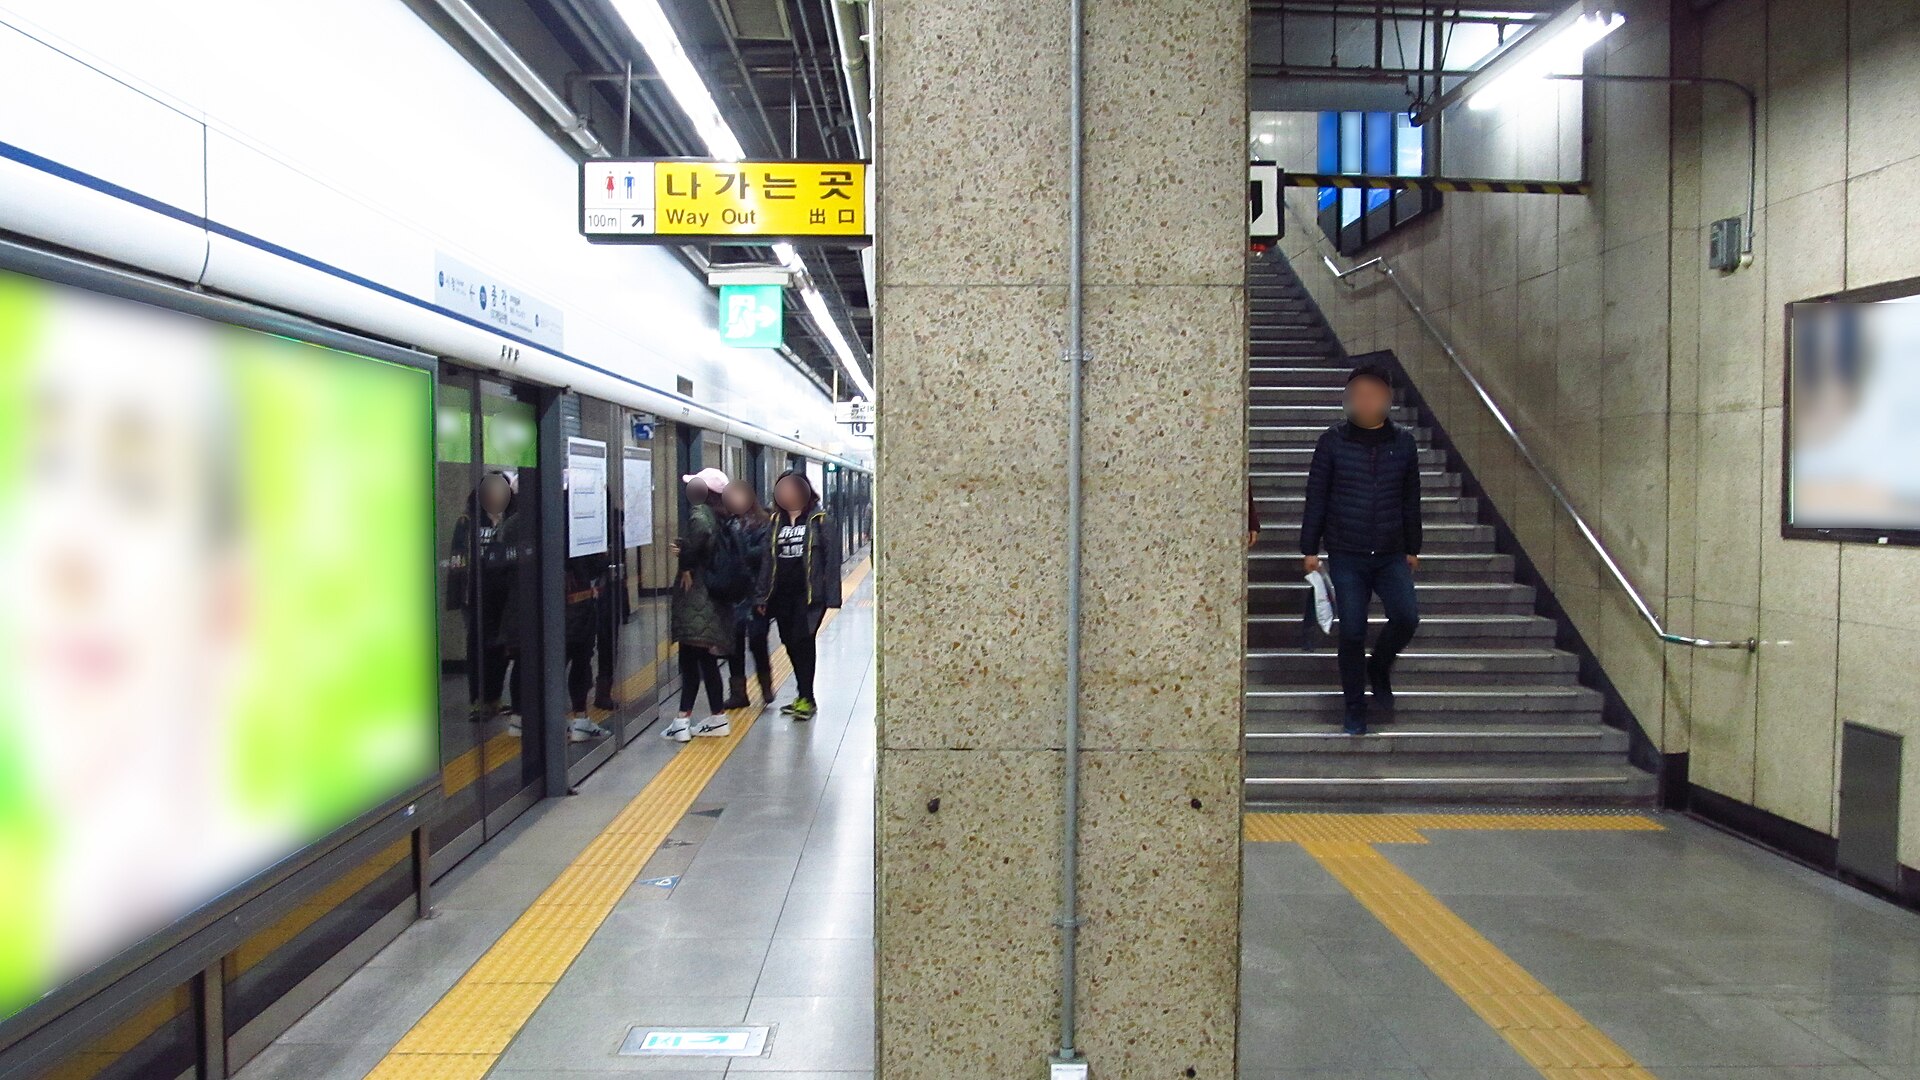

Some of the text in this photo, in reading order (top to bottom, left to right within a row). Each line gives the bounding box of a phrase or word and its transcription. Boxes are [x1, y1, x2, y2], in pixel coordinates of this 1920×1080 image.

[666, 171, 854, 200] 나가는 곳
[588, 214, 617, 227] 100m
[666, 208, 756, 227] Way Out
[809, 207, 855, 225] 出口
